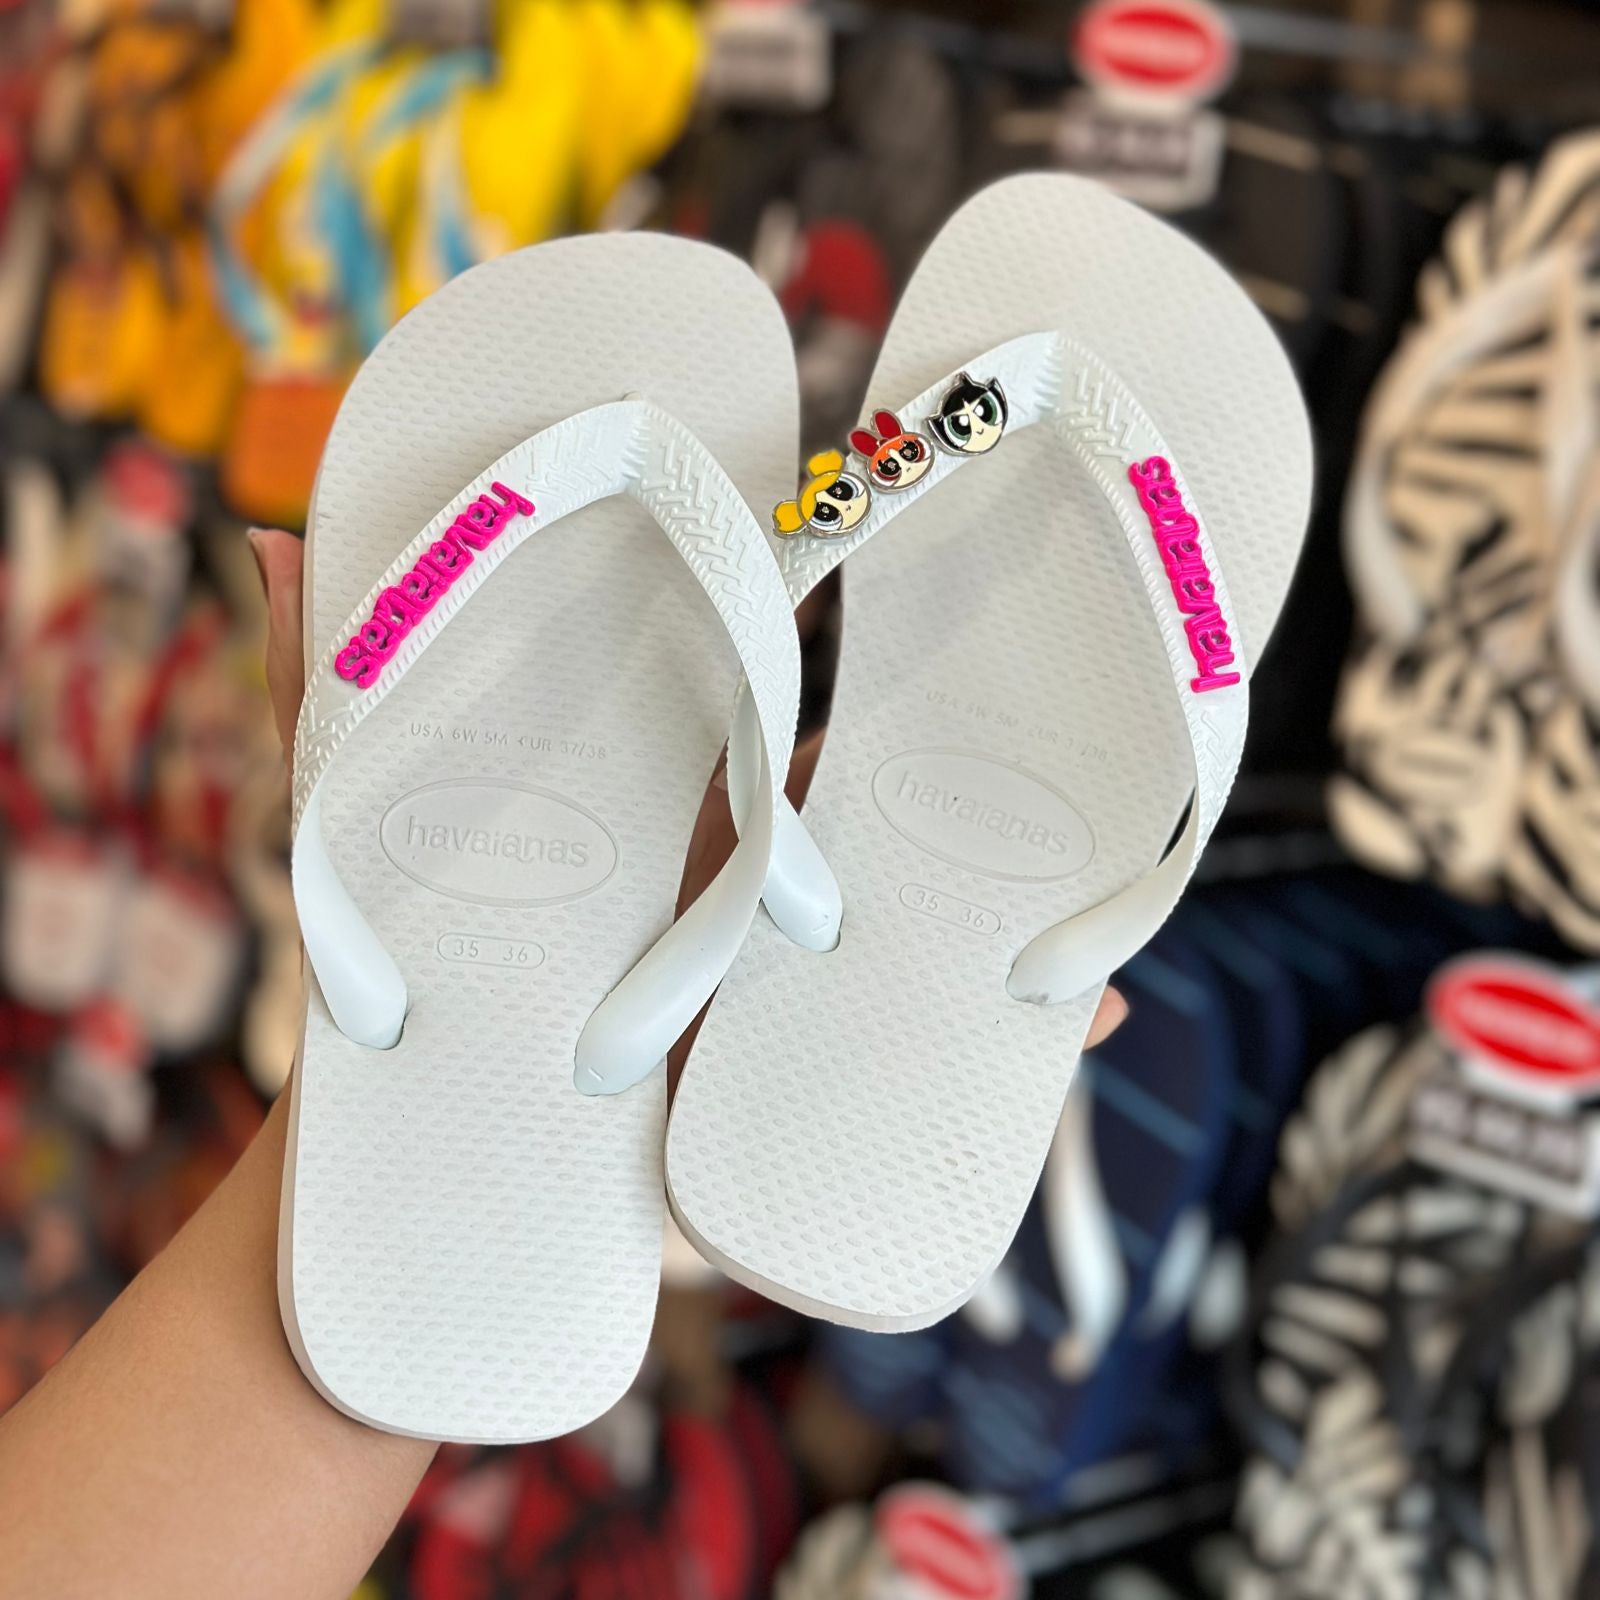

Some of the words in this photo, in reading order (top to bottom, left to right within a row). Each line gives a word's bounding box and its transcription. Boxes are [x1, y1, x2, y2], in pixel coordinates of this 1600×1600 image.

[334, 481, 536, 689] havaianas
[1128, 456, 1240, 693] havaianas
[411, 722, 443, 740] USA
[452, 728, 478, 743] 6W
[897, 769, 1070, 856] havaianas
[406, 814, 590, 868] havaianas
[912, 889, 941, 912] 35
[960, 906, 985, 928] 36
[453, 939, 480, 959] 35
[503, 945, 529, 964] 36
